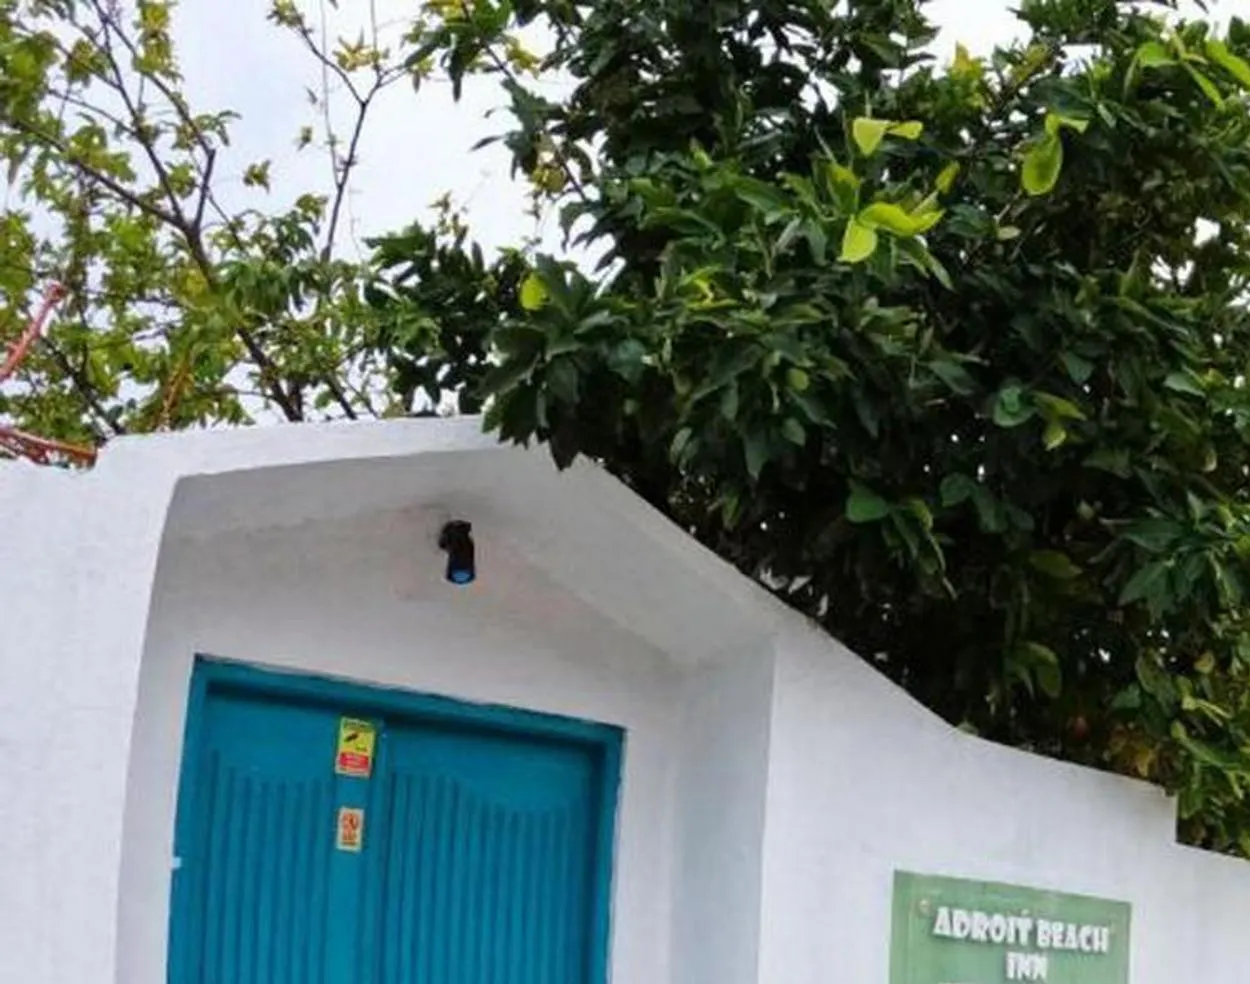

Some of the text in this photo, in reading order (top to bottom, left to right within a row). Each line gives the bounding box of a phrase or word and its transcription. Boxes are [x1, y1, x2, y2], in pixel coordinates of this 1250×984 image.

[933, 906, 1109, 953] ADROIT BEACH
[1006, 952, 1048, 980] INN
